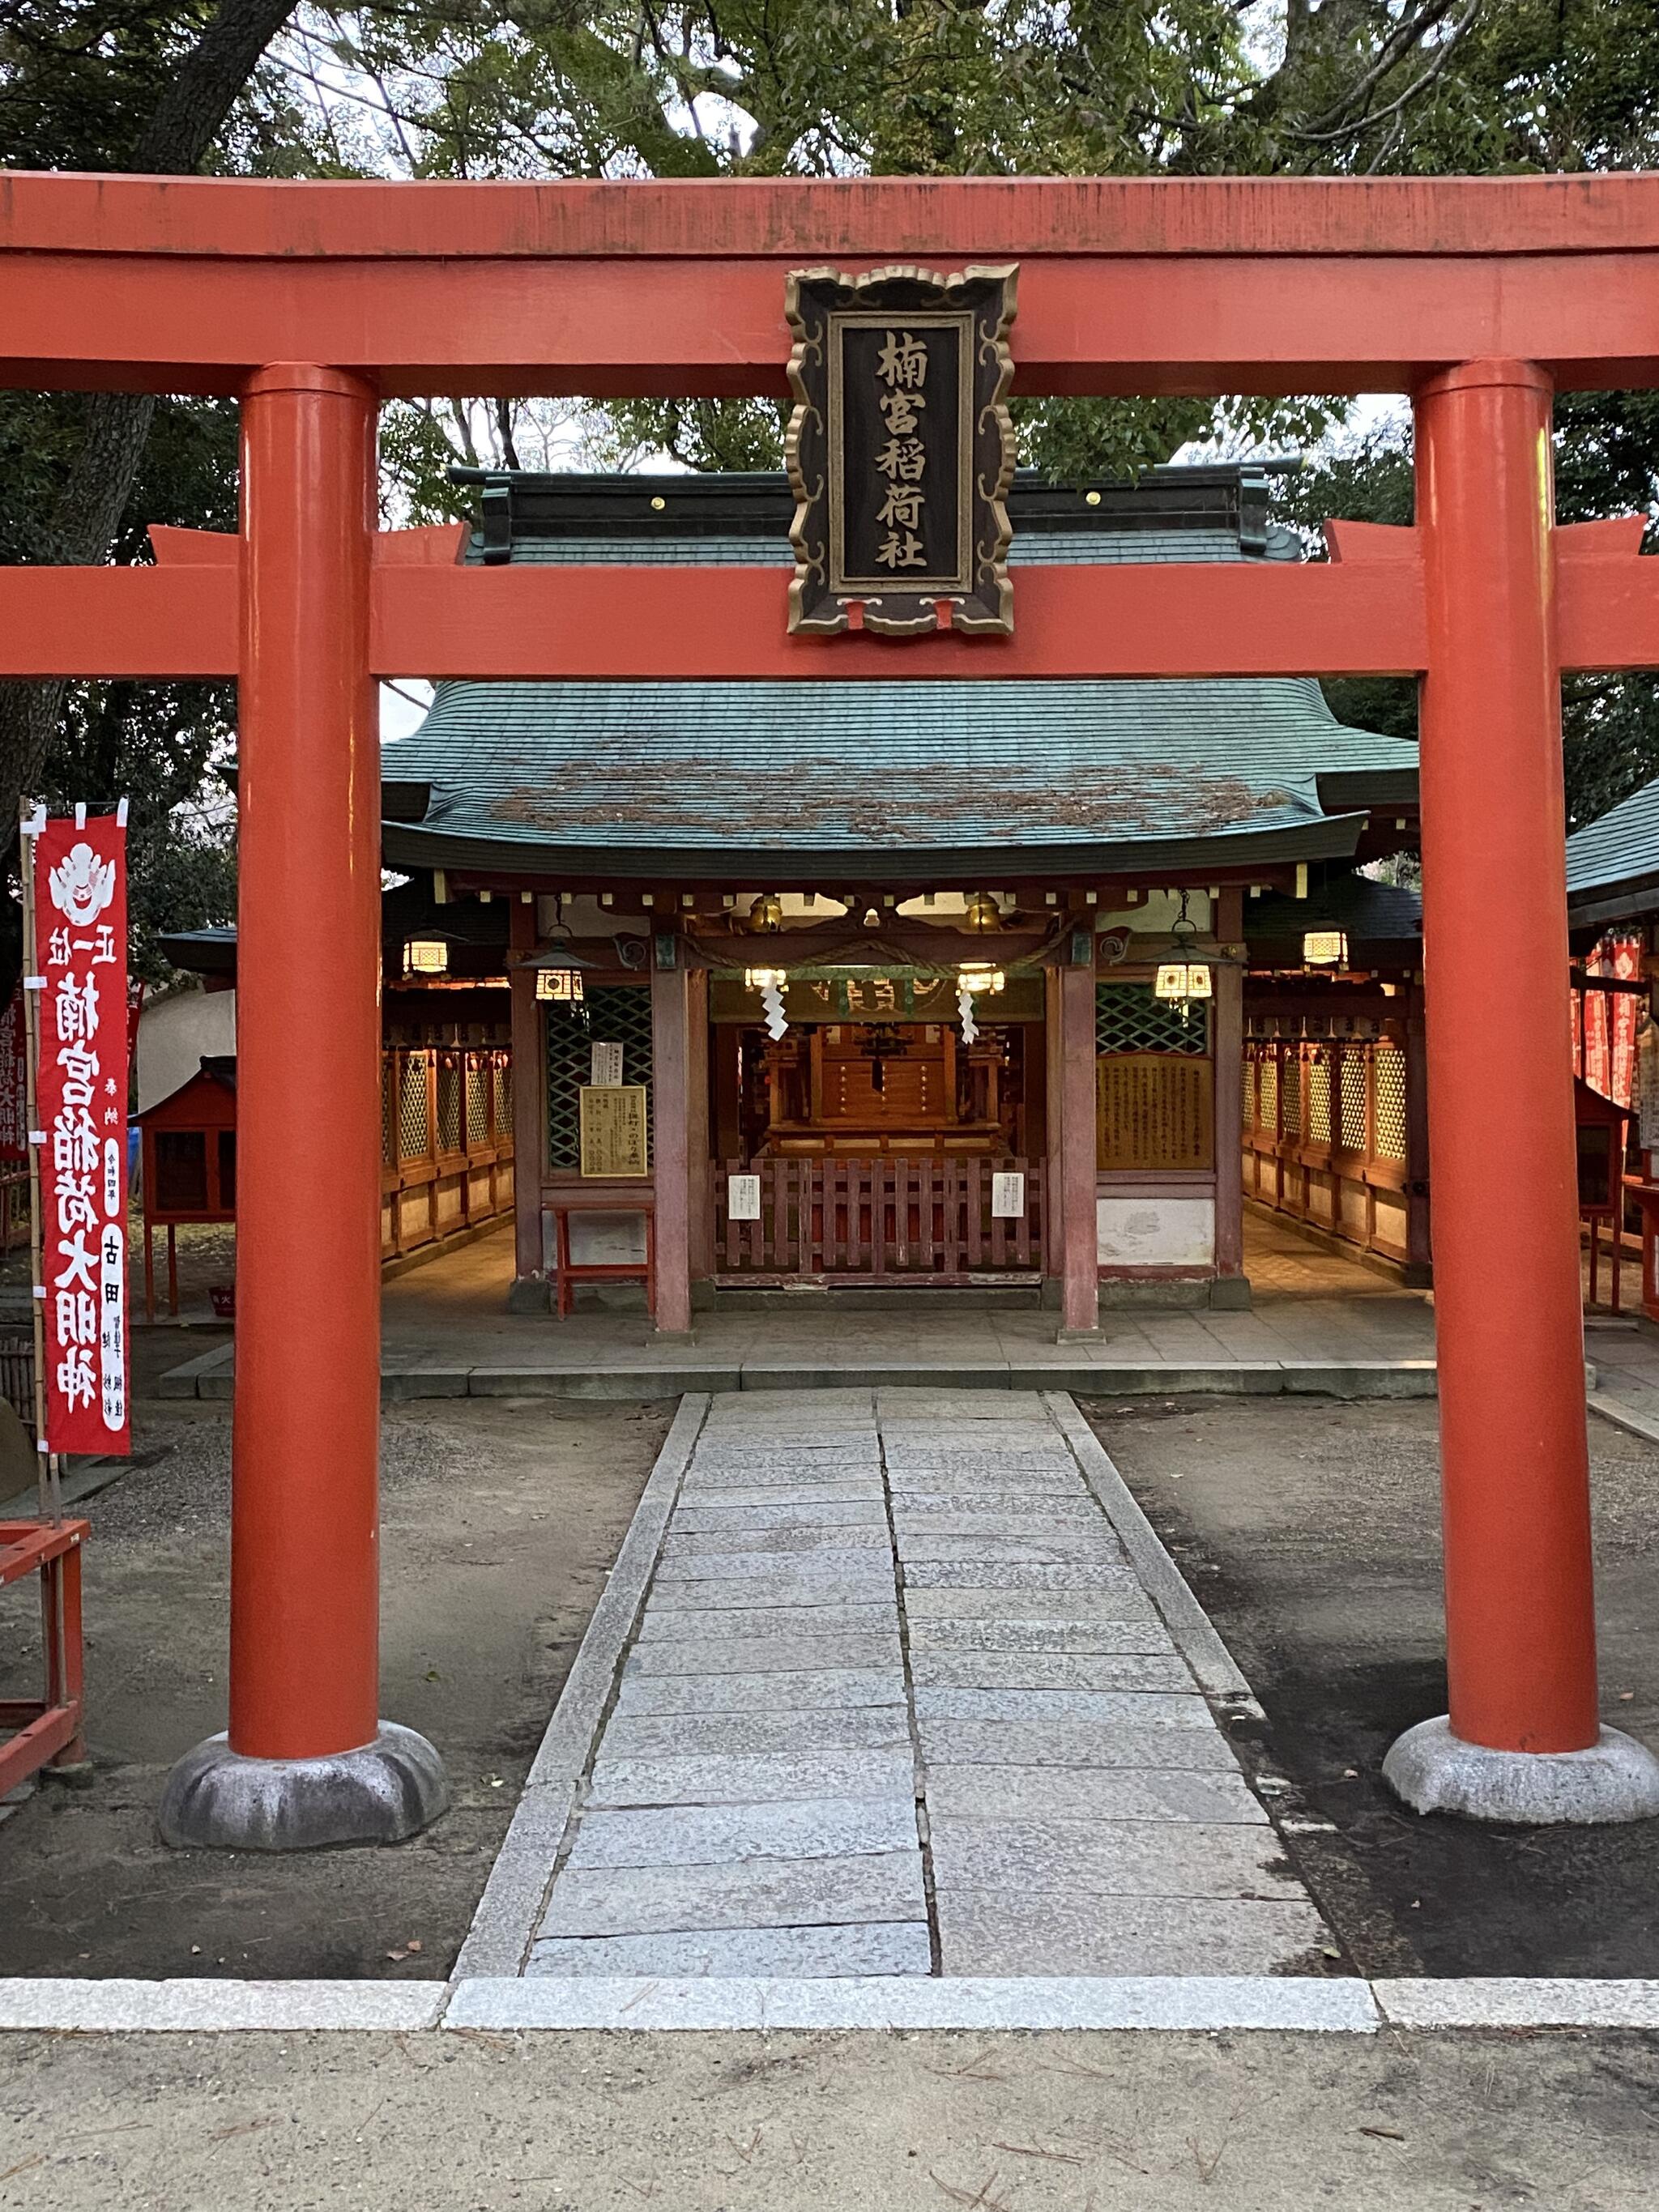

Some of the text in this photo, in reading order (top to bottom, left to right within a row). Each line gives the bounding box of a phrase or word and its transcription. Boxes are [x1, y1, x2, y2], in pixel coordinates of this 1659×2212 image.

[875, 330, 928, 569] 楠宮稲荷社
